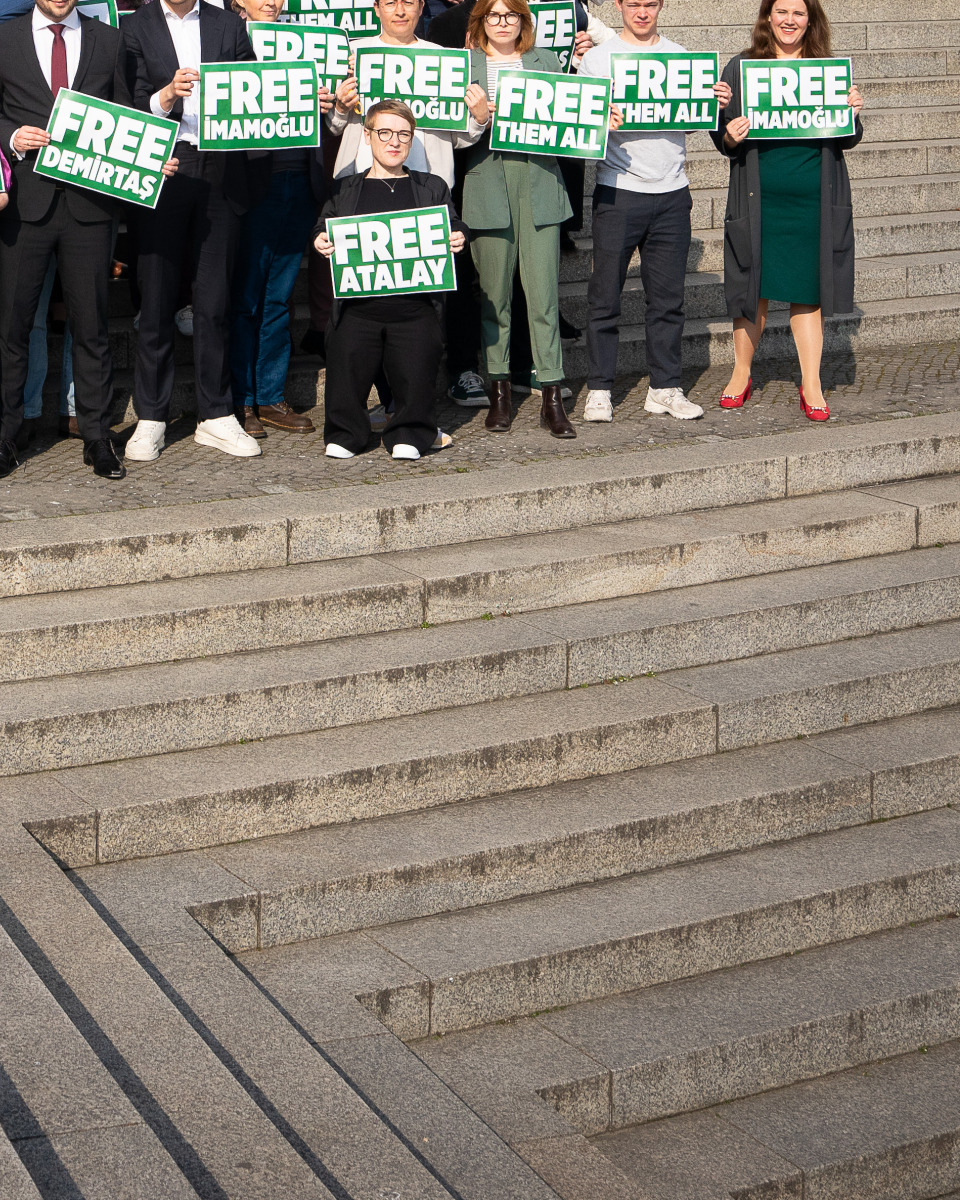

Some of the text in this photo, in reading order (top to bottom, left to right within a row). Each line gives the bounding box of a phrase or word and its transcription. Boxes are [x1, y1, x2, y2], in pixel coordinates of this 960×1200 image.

[340, 11, 378, 31] ALL
[204, 68, 314, 115] FREE
[359, 53, 465, 98] FREE
[613, 59, 715, 99] FREE
[746, 66, 848, 107] FREE
[498, 76, 607, 126] FREE
[674, 102, 713, 122] ALL
[748, 106, 850, 129] İMAMOĞLU
[50, 98, 172, 172] FREE
[203, 113, 314, 140] İMAMOĞLU
[496, 120, 601, 151] THEM ALL
[41, 145, 157, 200] DEMİRTAŞ
[332, 213, 447, 265] FREE
[339, 258, 447, 292] ATALAY
